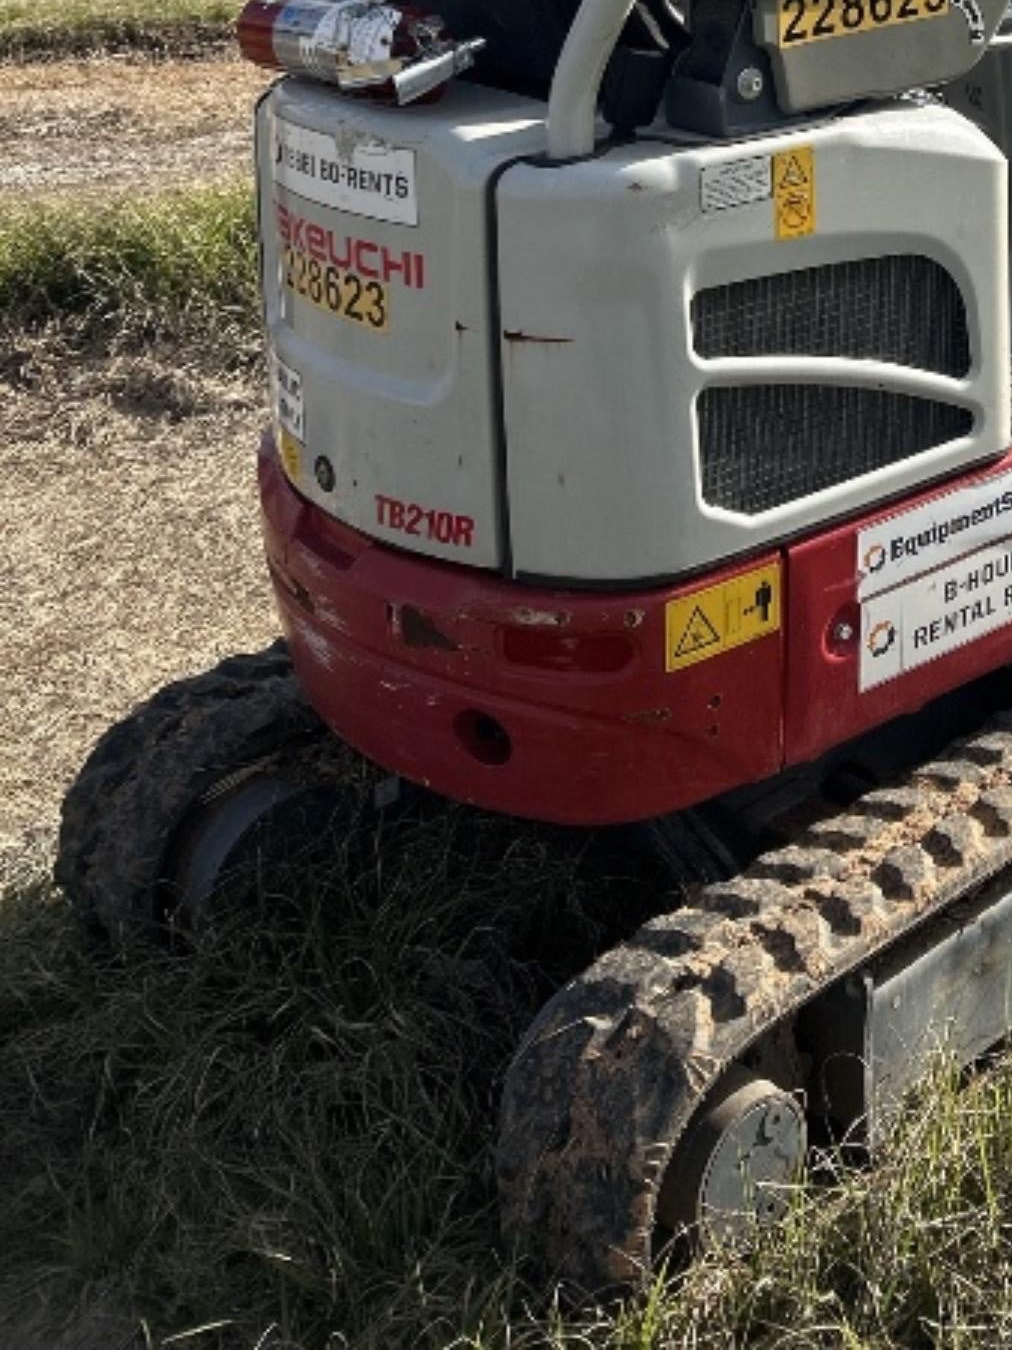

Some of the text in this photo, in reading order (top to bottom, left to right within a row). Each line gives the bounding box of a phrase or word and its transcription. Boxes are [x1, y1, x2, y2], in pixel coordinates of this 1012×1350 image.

[284, 244, 387, 328] 228623
[374, 494, 476, 547] TB210R
[913, 596, 997, 648] RENTAL
